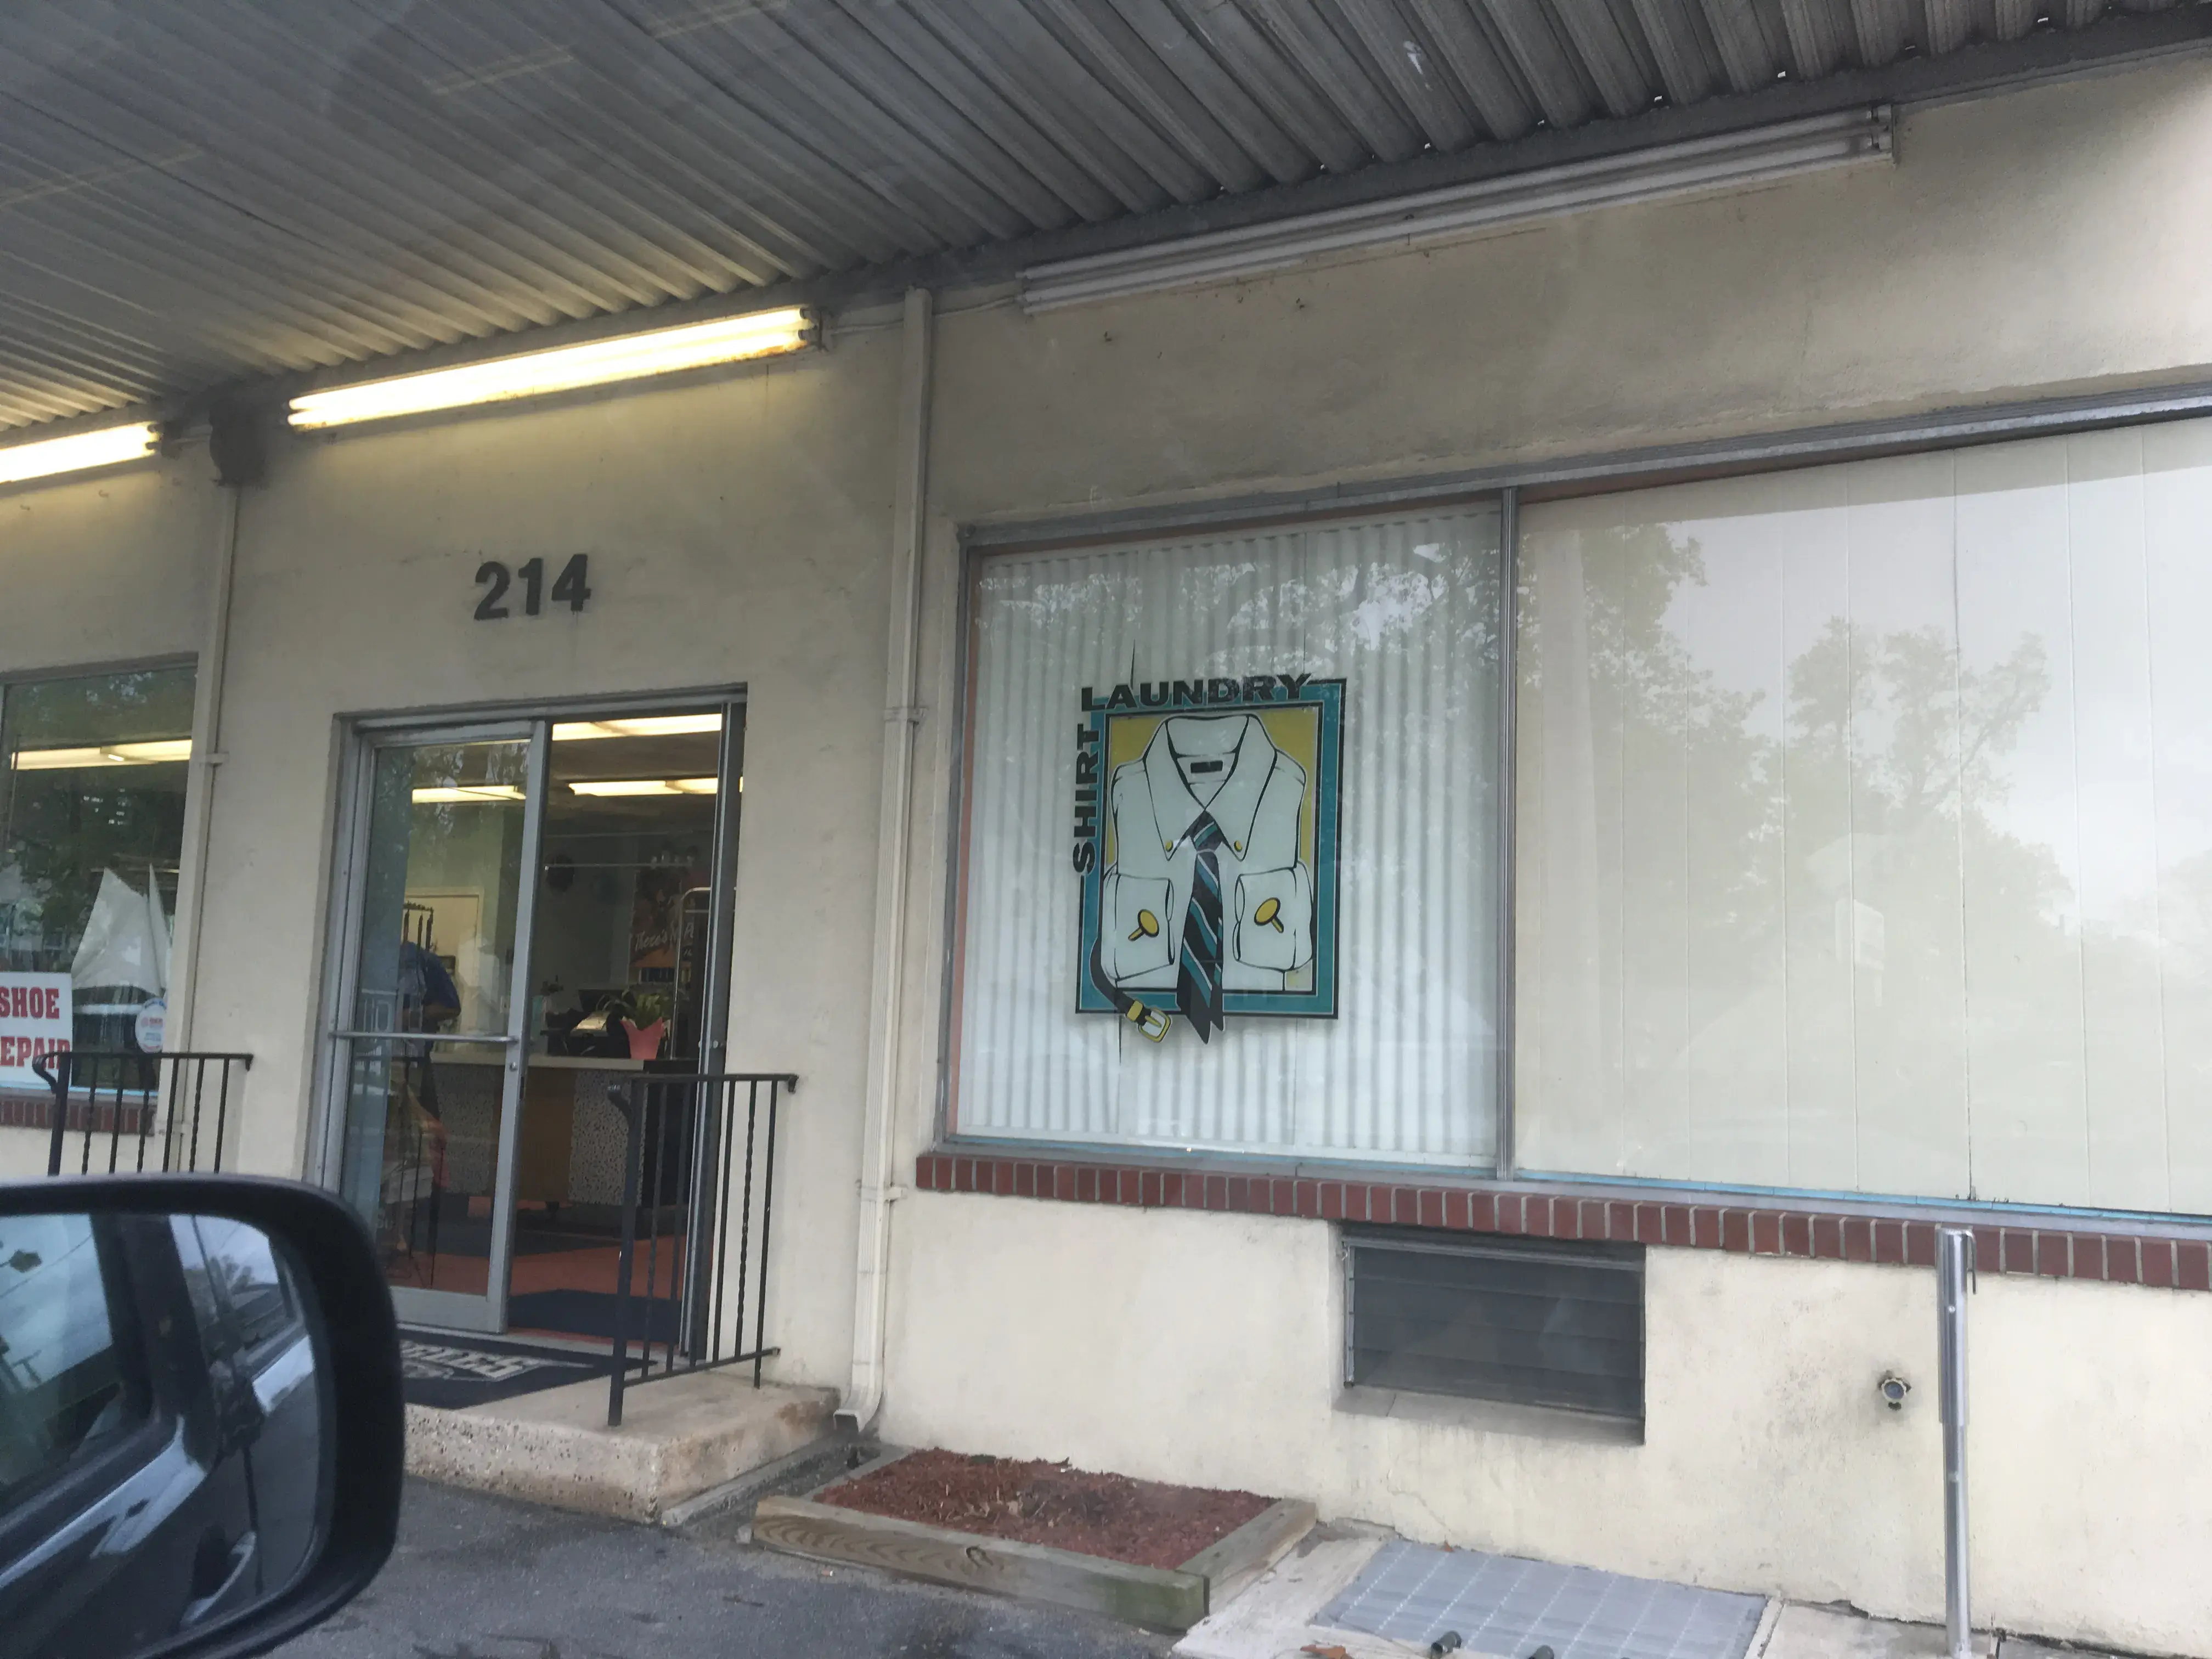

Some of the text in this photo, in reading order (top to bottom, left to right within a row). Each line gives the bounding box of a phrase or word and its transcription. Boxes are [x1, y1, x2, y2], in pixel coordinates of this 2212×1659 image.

[473, 553, 591, 620] 214
[1080, 673, 1312, 712] LAUNDRY
[1073, 723, 1099, 874] SHIRT
[0, 986, 59, 1019] SHOE
